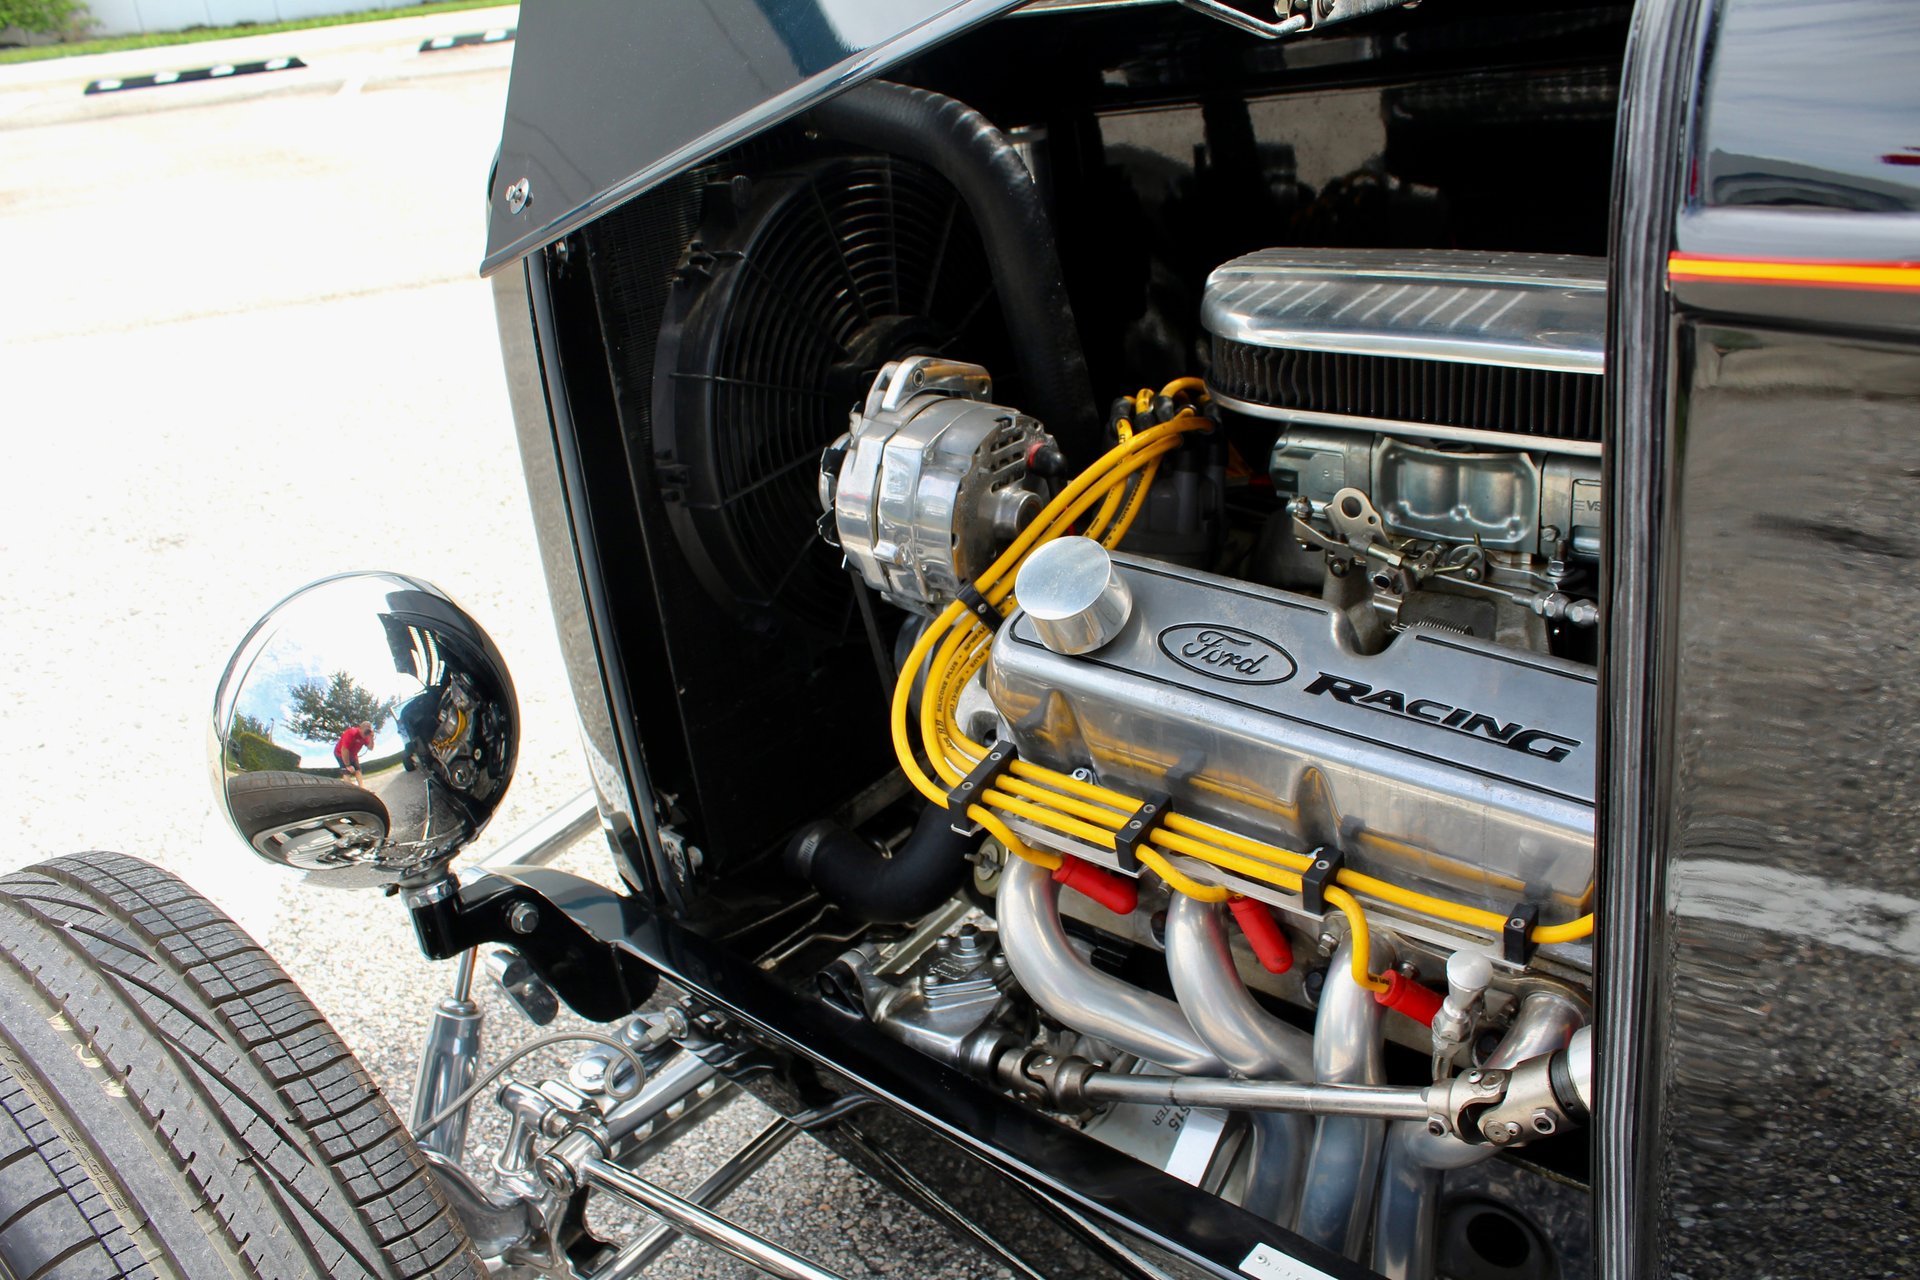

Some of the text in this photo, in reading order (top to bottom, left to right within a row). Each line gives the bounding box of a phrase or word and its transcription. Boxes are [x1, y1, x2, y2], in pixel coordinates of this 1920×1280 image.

[936, 680, 949, 712] SILICONE
[946, 660, 959, 679] PLUS
[1181, 628, 1582, 763] Ford RACING
[61, 1125, 129, 1213] EAGLE
